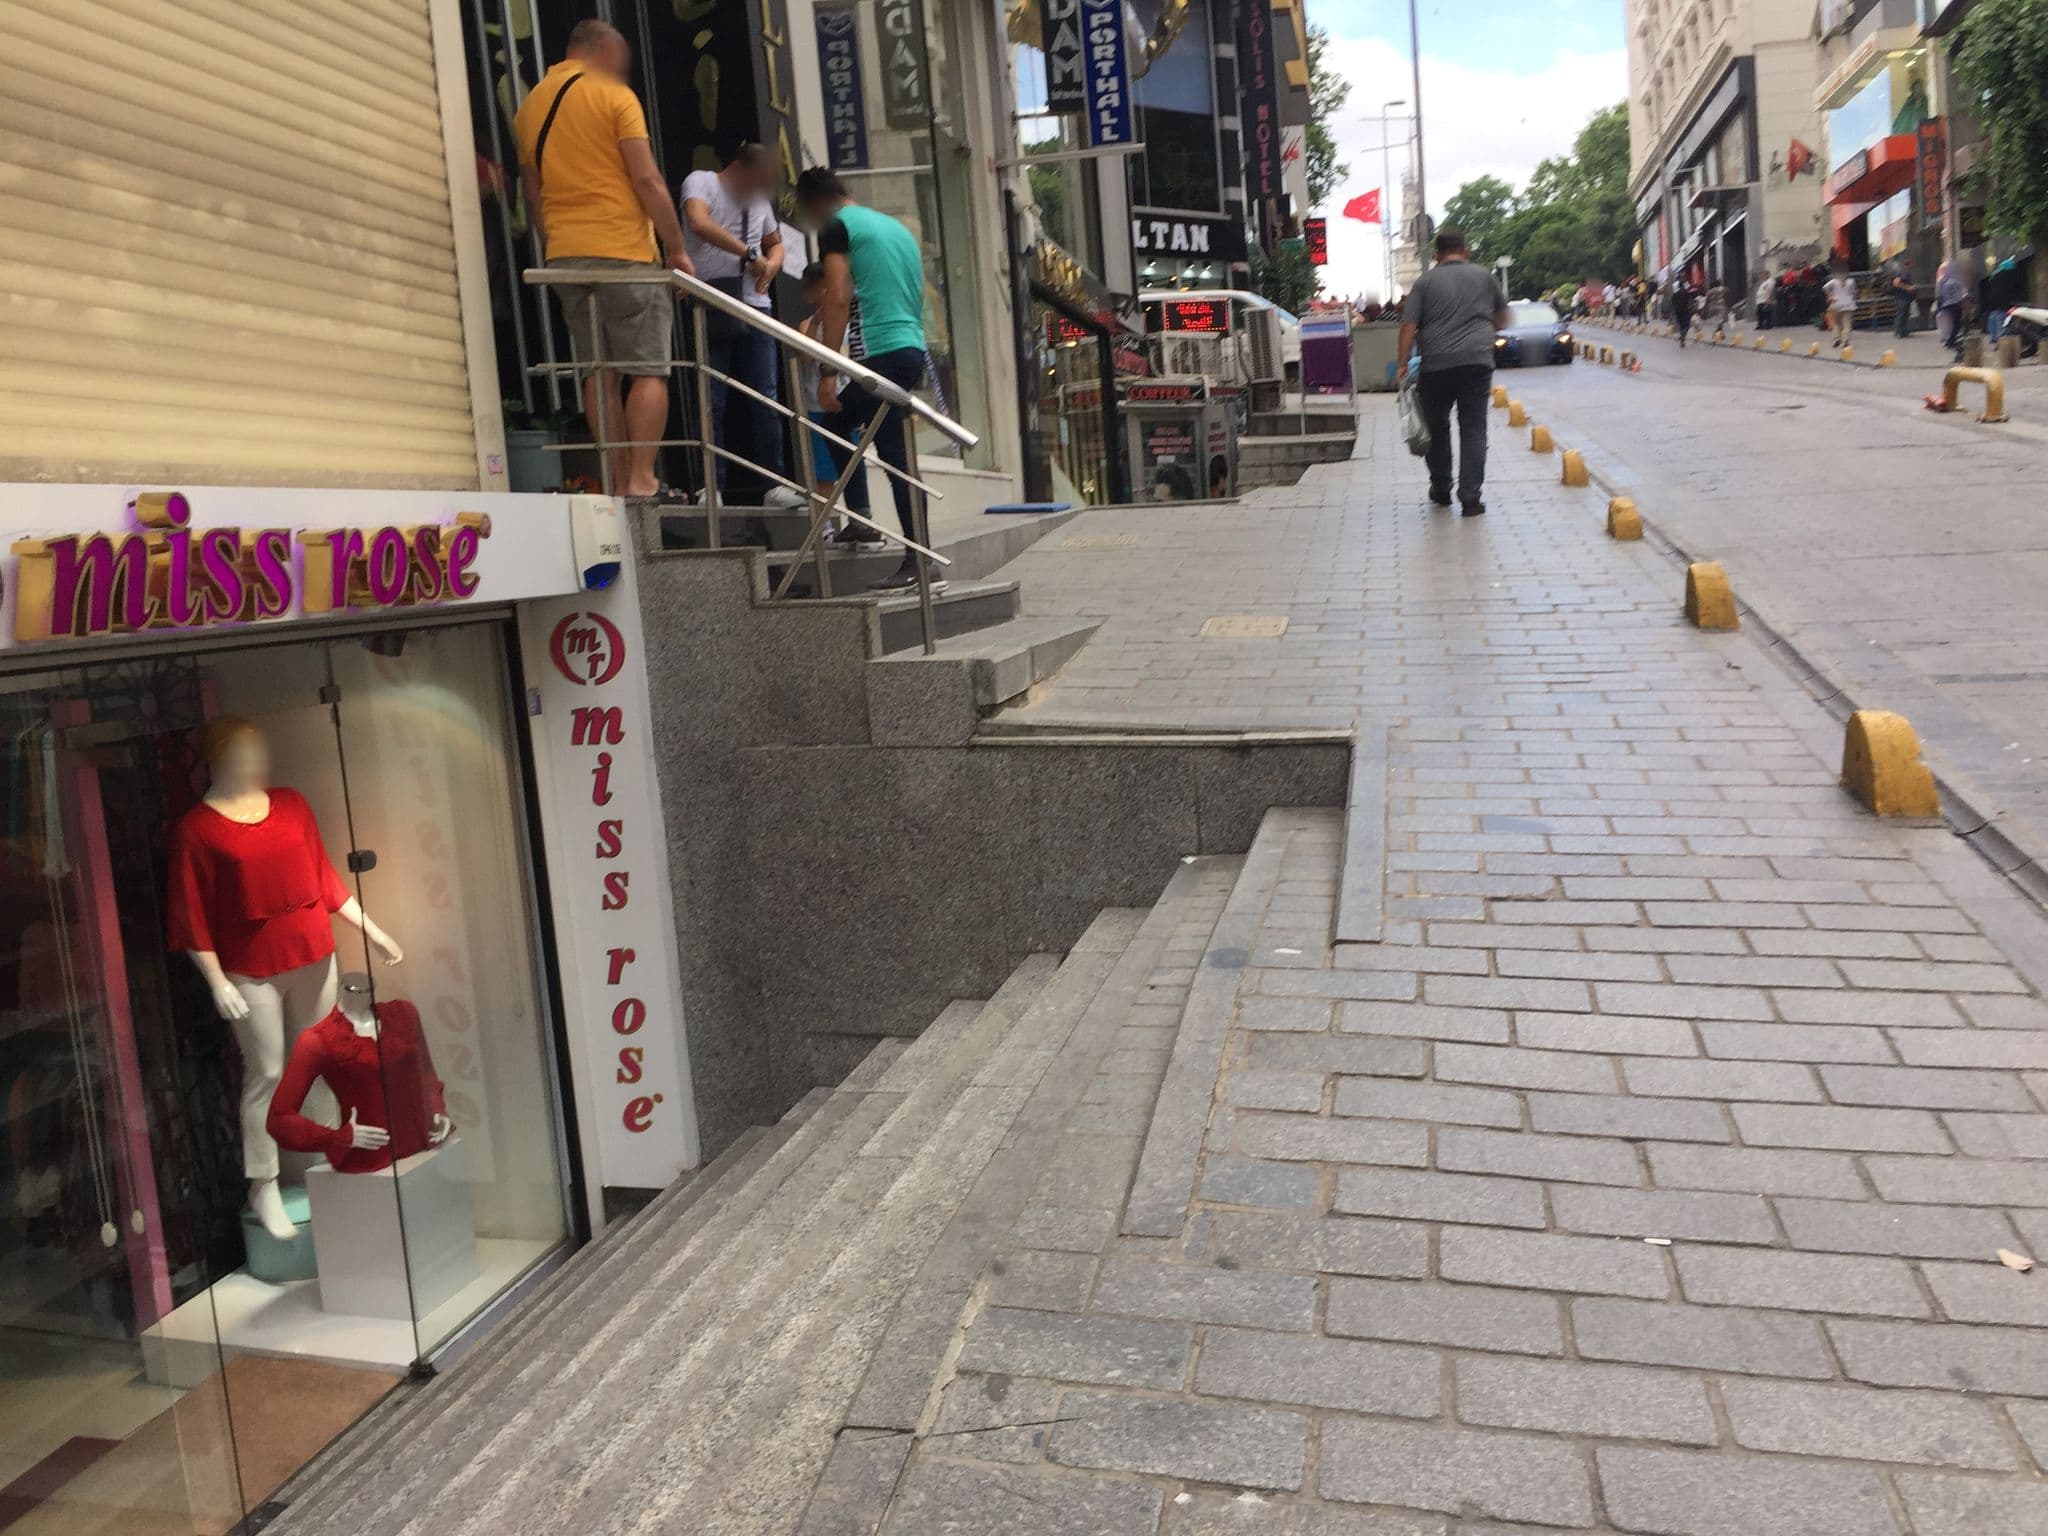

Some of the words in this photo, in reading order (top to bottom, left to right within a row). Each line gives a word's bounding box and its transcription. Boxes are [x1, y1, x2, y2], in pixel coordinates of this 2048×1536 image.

[1088, 11, 1120, 141] PORTHALL
[1256, 104, 1273, 194] HOTEL
[46, 491, 294, 638] miss
[326, 522, 482, 609] rose
[570, 706, 629, 911] miss
[606, 947, 656, 1134] rose
